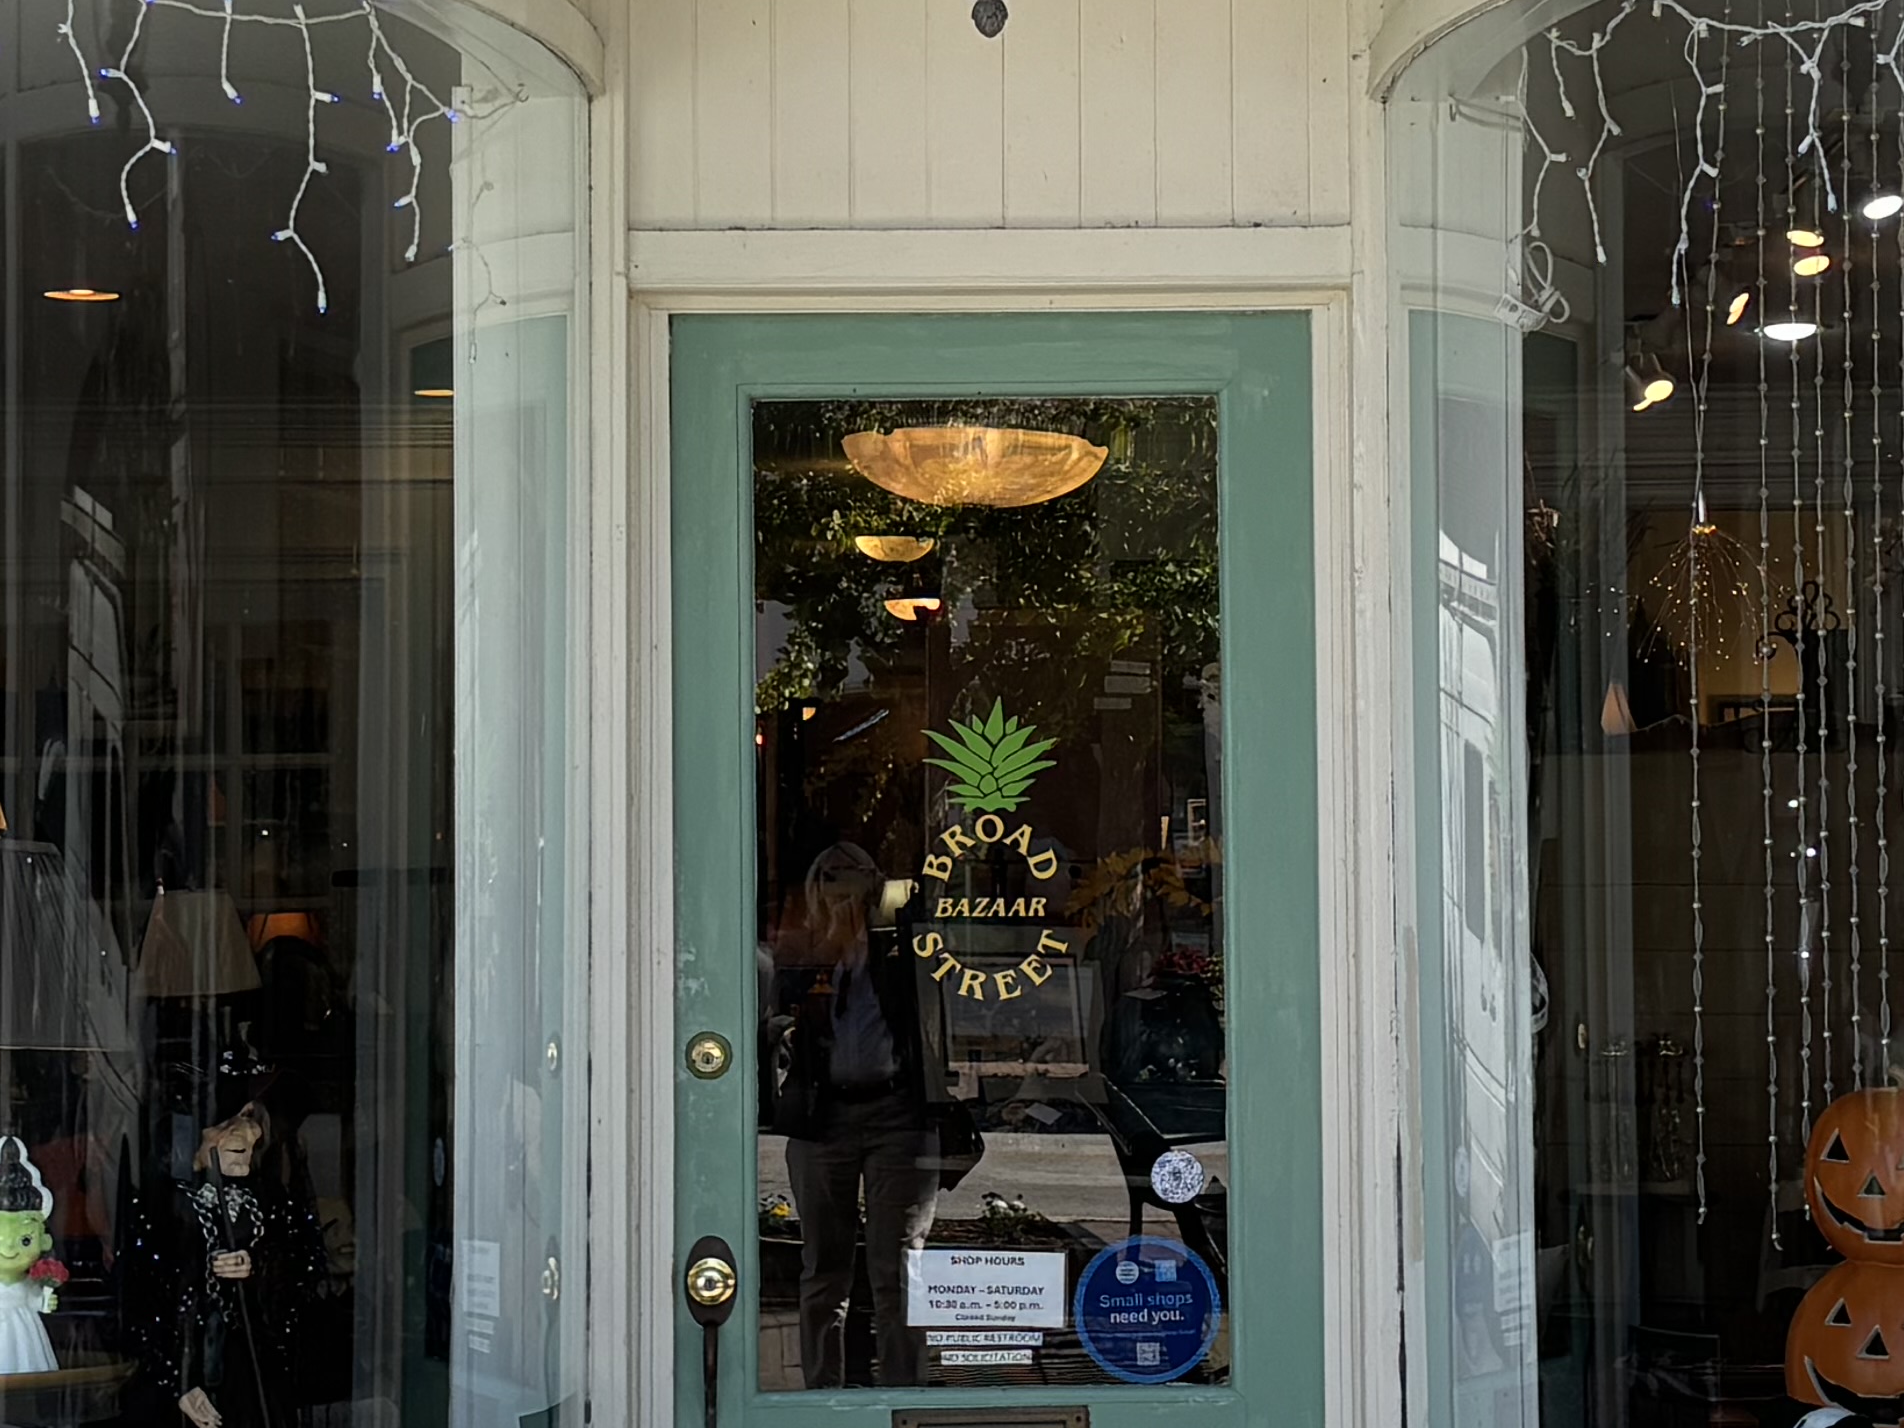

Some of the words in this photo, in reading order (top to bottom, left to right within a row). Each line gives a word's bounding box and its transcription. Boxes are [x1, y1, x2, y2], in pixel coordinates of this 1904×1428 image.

[922, 814, 1058, 883] BROAD
[935, 897, 1047, 917] BAZAAR
[912, 929, 1069, 1001] STREET
[985, 1256, 1025, 1266] HOURS
[928, 1284, 977, 1295] MONDAY
[986, 1285, 1045, 1296] SATURDAY
[1099, 1293, 1143, 1308] Small
[1147, 1293, 1194, 1309] shops
[1109, 1308, 1148, 1324] need
[1151, 1310, 1185, 1325] you.
